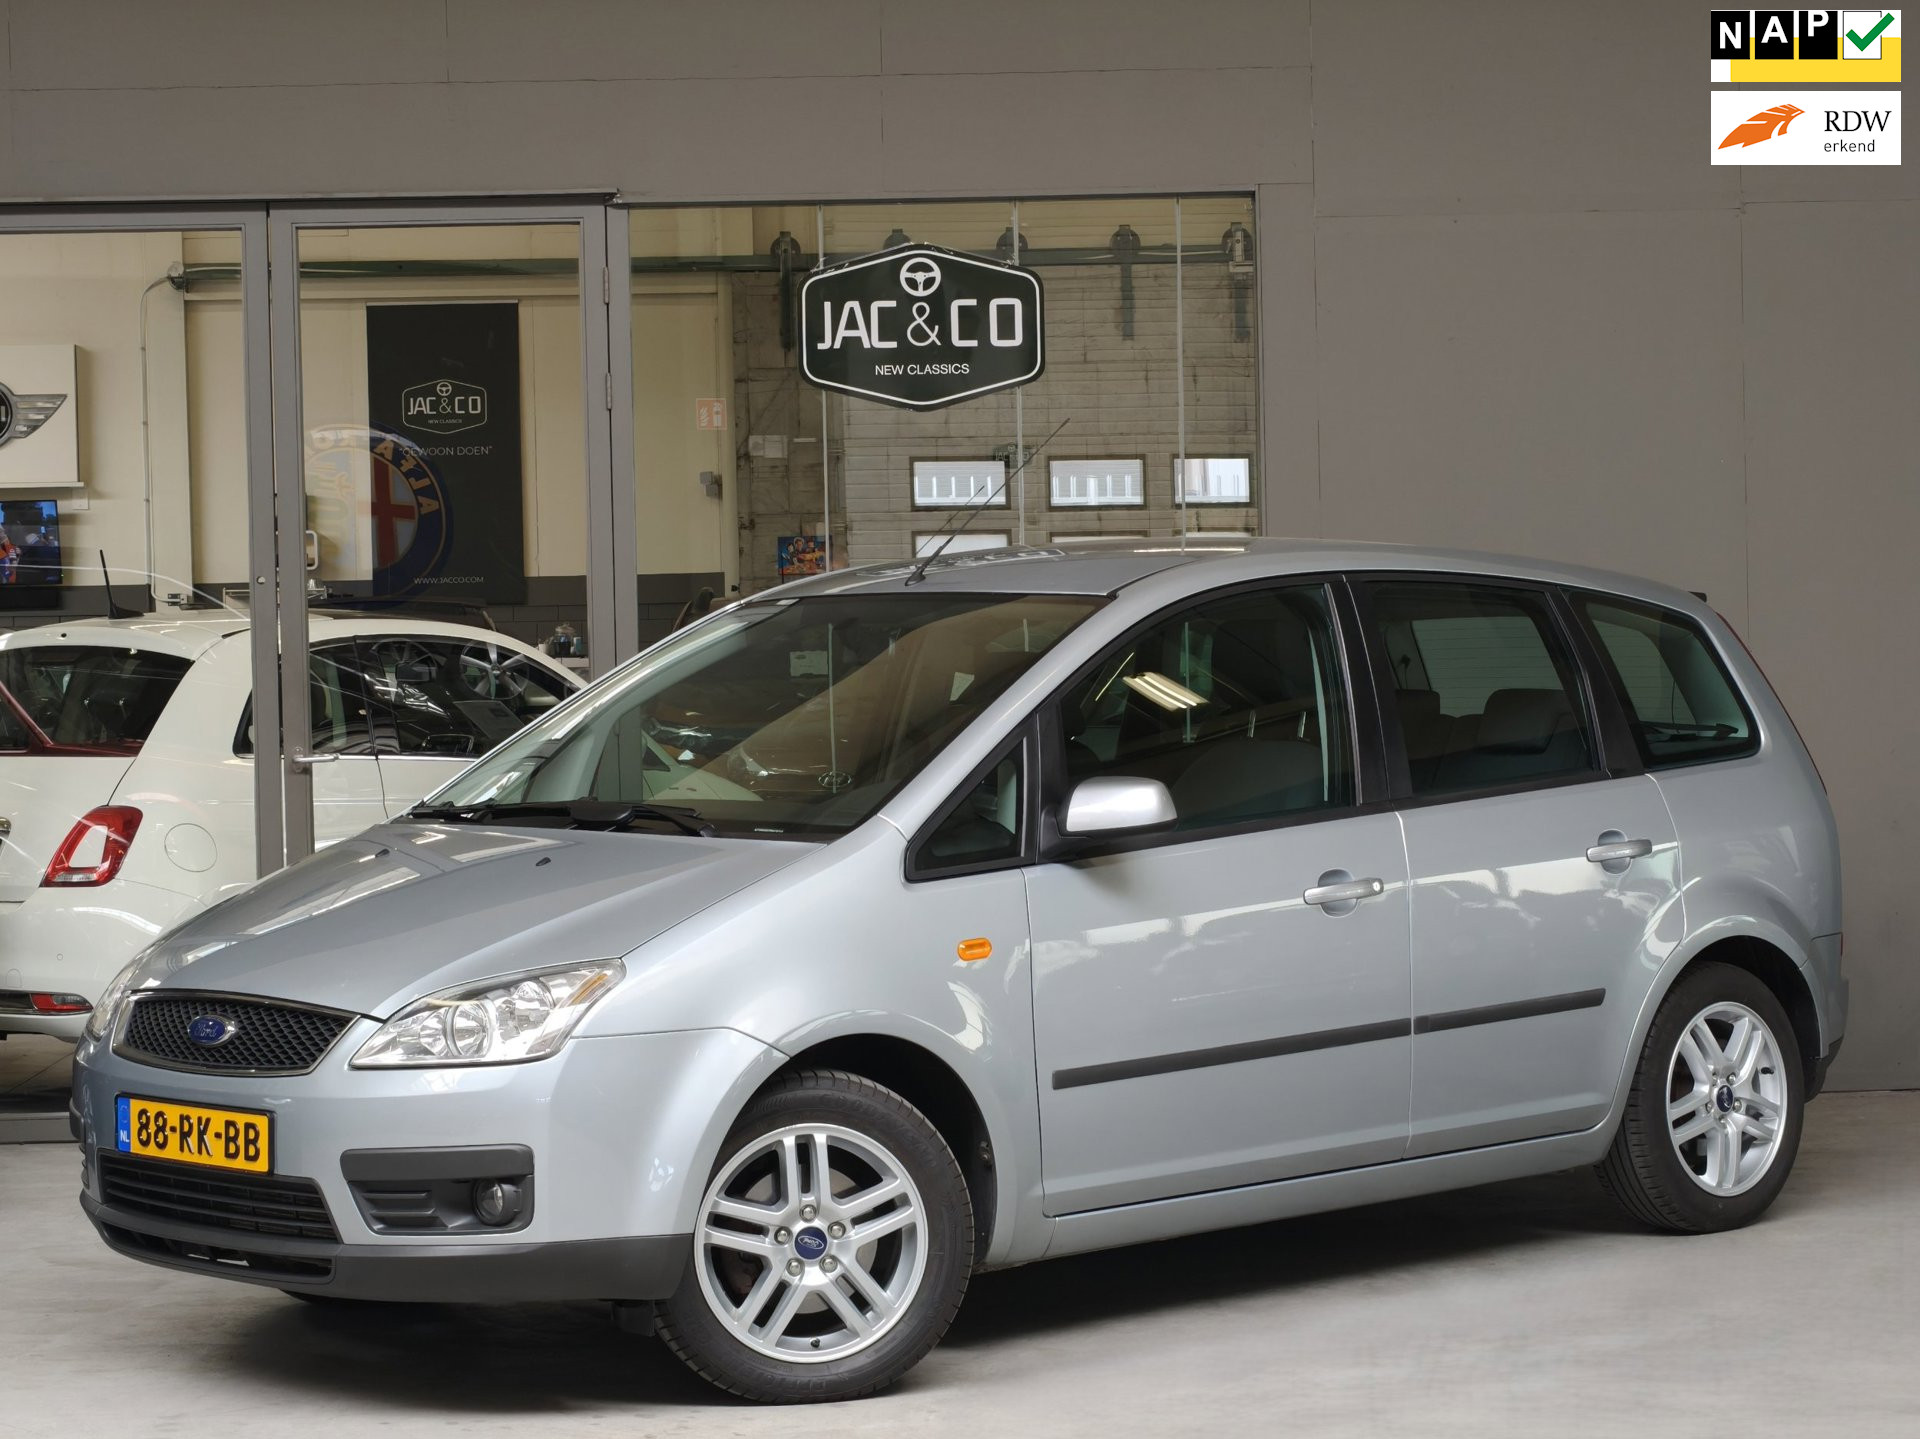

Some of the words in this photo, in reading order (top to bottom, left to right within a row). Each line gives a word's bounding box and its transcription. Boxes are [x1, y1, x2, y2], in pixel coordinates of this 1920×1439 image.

[817, 301, 898, 350] JAC
[906, 302, 942, 347] &
[951, 298, 1023, 347] CO
[875, 365, 904, 376] NEW
[907, 364, 970, 375] CLASSICS
[407, 396, 437, 415] JAC
[439, 397, 452, 413] &
[455, 396, 481, 414] CO
[413, 576, 484, 585] WWW.JACCO.COM
[193, 1022, 218, 1038] Ford
[120, 1130, 130, 1143] NL
[137, 1108, 261, 1163] 88-RK-BB
